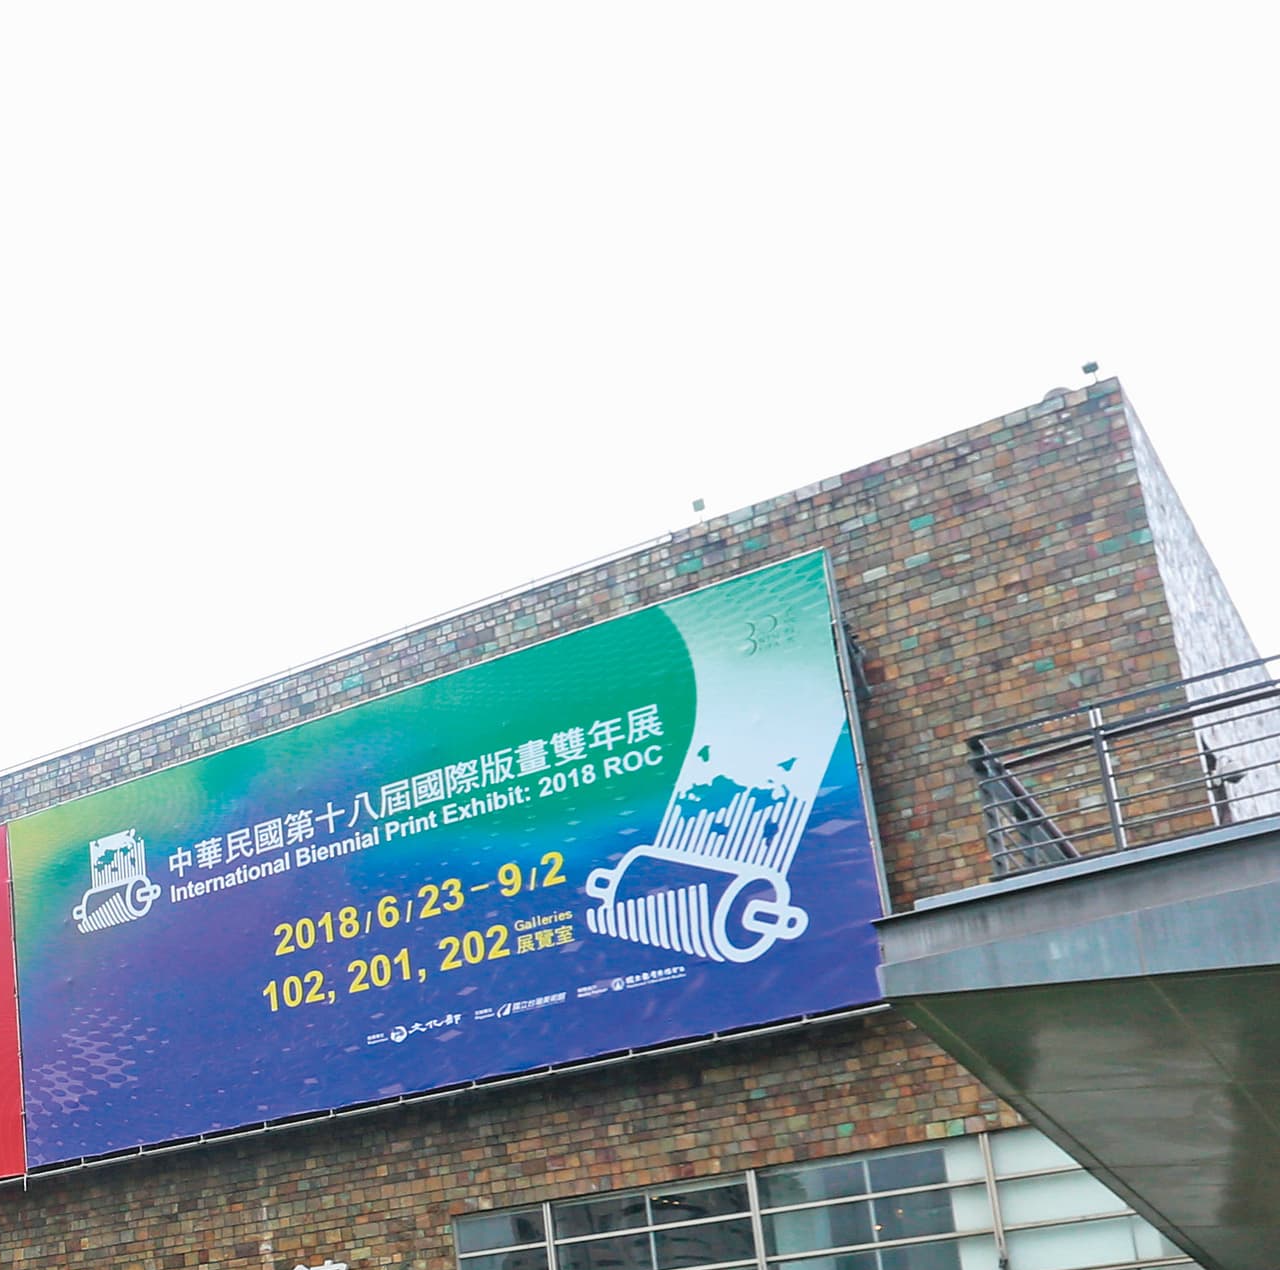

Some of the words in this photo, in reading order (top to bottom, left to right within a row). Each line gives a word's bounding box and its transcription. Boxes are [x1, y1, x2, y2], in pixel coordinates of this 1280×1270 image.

[168, 703, 665, 878] 中華民國第十八屆國際版畫雙年展
[170, 852, 290, 903] International
[295, 826, 380, 868] Biennial
[385, 811, 438, 842] Print
[442, 786, 532, 825] Exhibit:
[538, 764, 597, 798] 2018
[603, 745, 664, 779] ROC
[514, 911, 573, 932] Galleries
[516, 925, 575, 955] 展覽室
[262, 969, 336, 1012] 102,
[347, 948, 427, 994] 201,
[438, 924, 511, 972] 202
